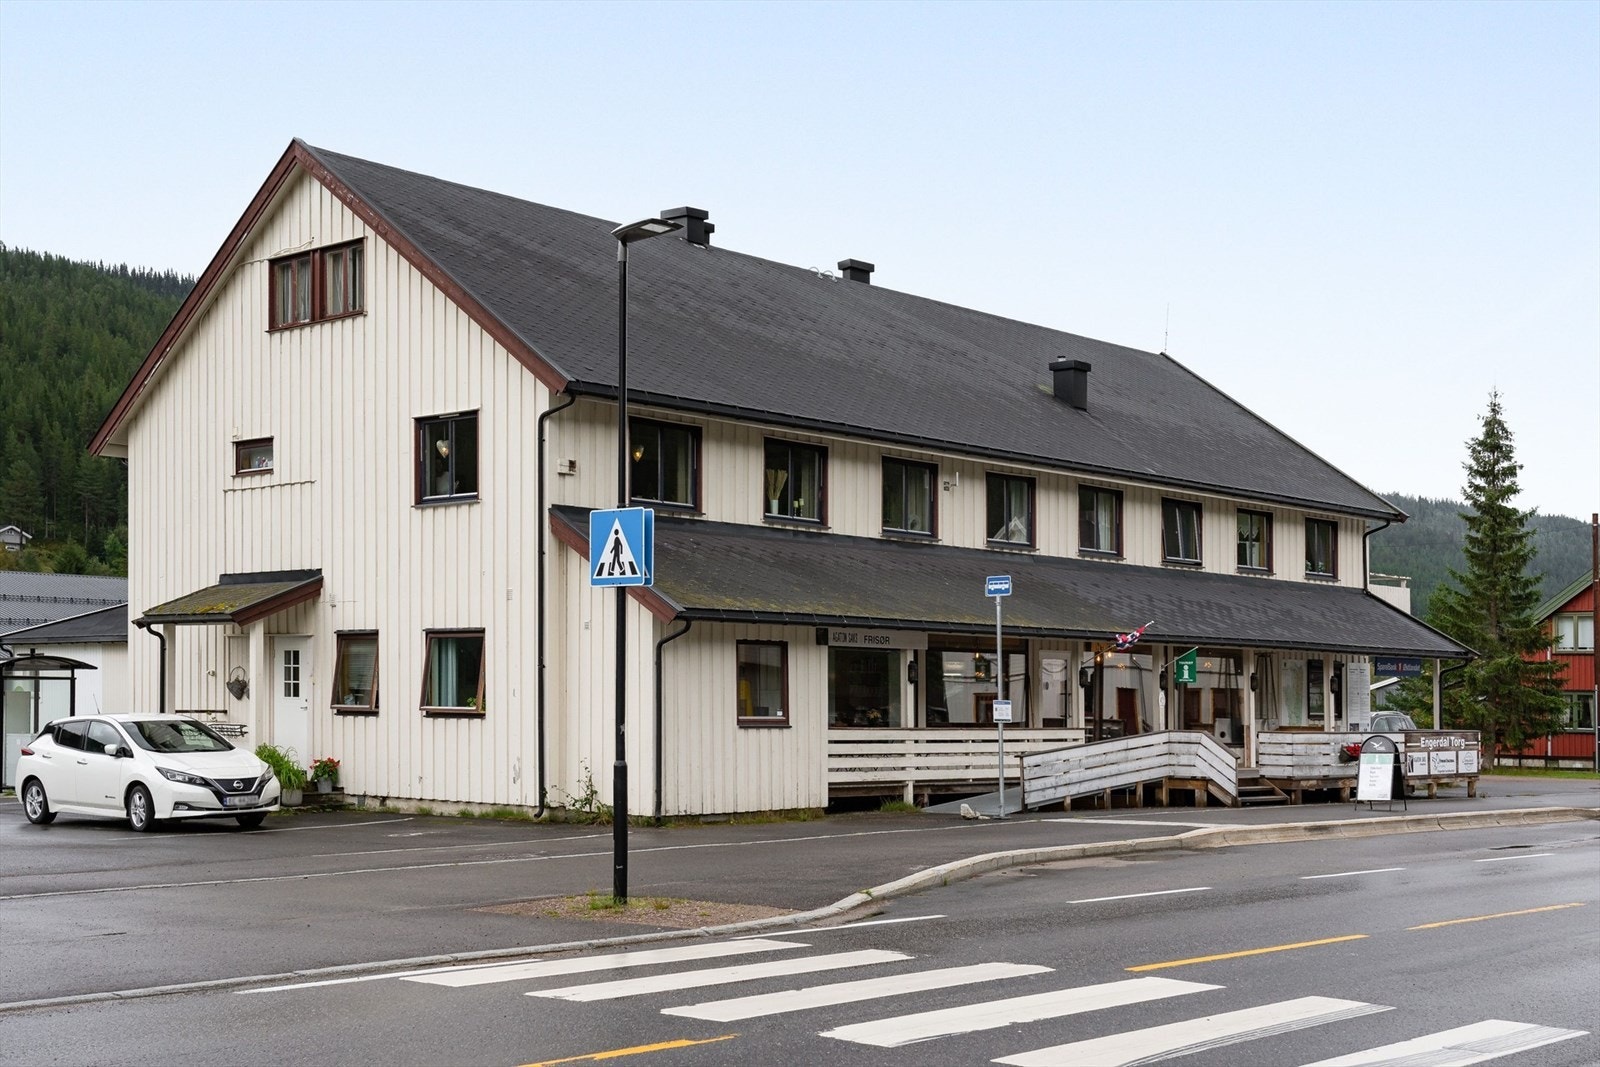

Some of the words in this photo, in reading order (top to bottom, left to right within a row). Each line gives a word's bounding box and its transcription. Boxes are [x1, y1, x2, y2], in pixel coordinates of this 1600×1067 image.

[864, 635, 890, 644] FRISØR
[1420, 736, 1449, 750] Engerdal
[1450, 736, 1465, 749] Torg
